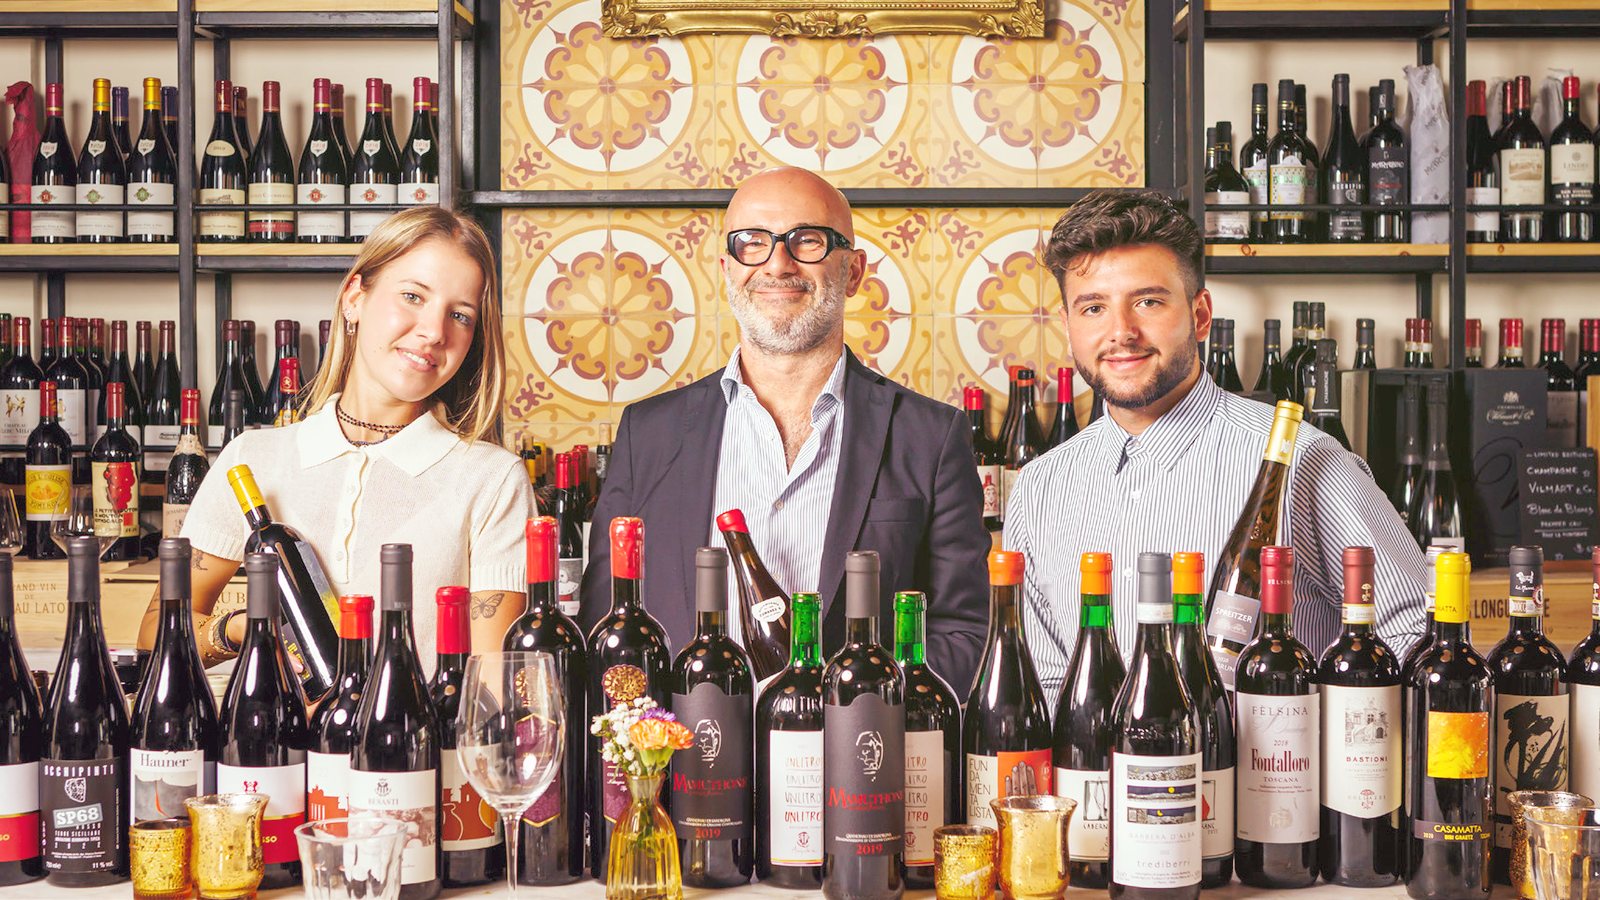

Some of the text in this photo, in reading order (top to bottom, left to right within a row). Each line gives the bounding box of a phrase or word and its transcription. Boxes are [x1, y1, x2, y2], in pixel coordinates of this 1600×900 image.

[1526, 466, 1579, 475] CHAMPAGNE
[1528, 481, 1573, 494] VILMART
[40, 583, 57, 591] VIN
[1215, 607, 1253, 624] SPREITZER
[140, 753, 191, 768] Hauner
[969, 758, 989, 772] FUN
[1251, 748, 1310, 773] Fontalloro
[44, 764, 114, 777] OCCHIPINTI
[970, 771, 981, 783] DA
[969, 782, 991, 795] MEN
[970, 794, 980, 805] TA
[55, 806, 100, 826] SP68
[969, 805, 993, 819] LISTA
[696, 828, 721, 839] 2019
[1433, 824, 1482, 834] CASAMATTA
[857, 843, 883, 856] 2019
